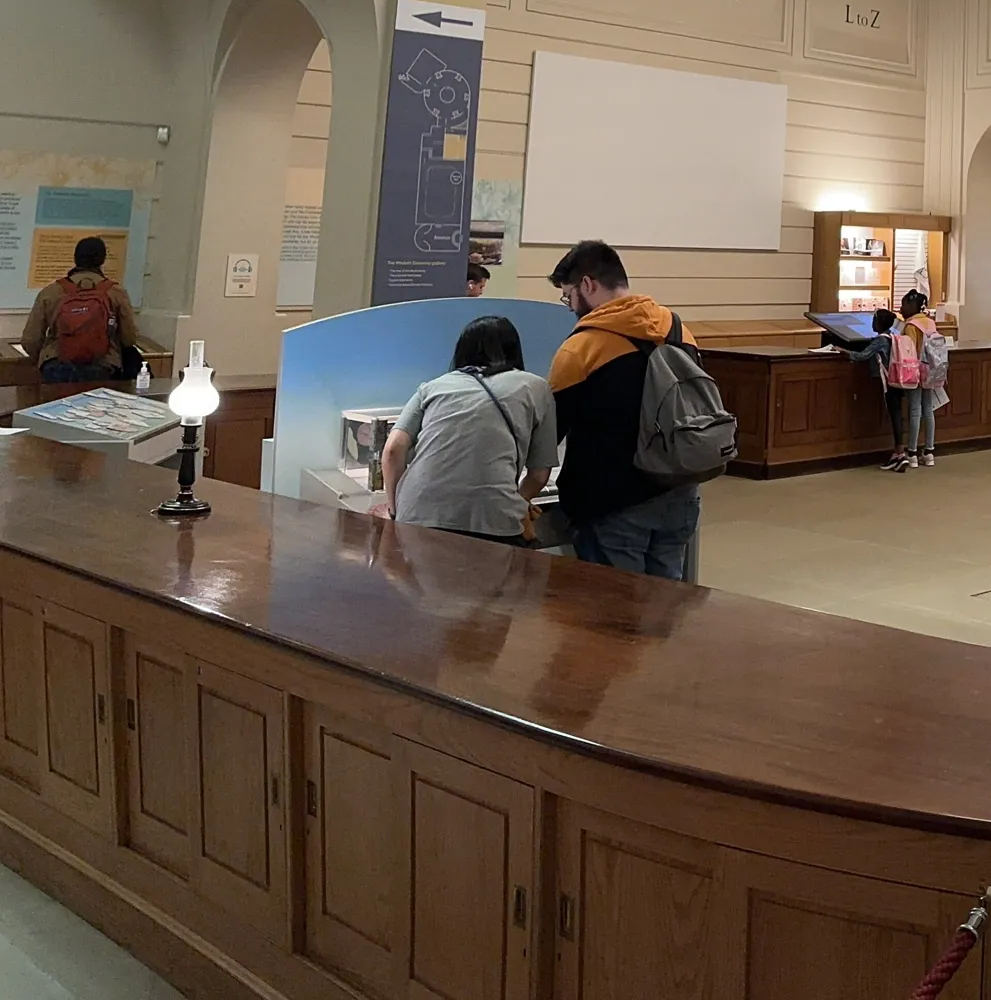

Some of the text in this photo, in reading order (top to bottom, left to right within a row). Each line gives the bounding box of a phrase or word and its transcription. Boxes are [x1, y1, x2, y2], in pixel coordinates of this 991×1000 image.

[845, 4, 880, 29] L to Z
